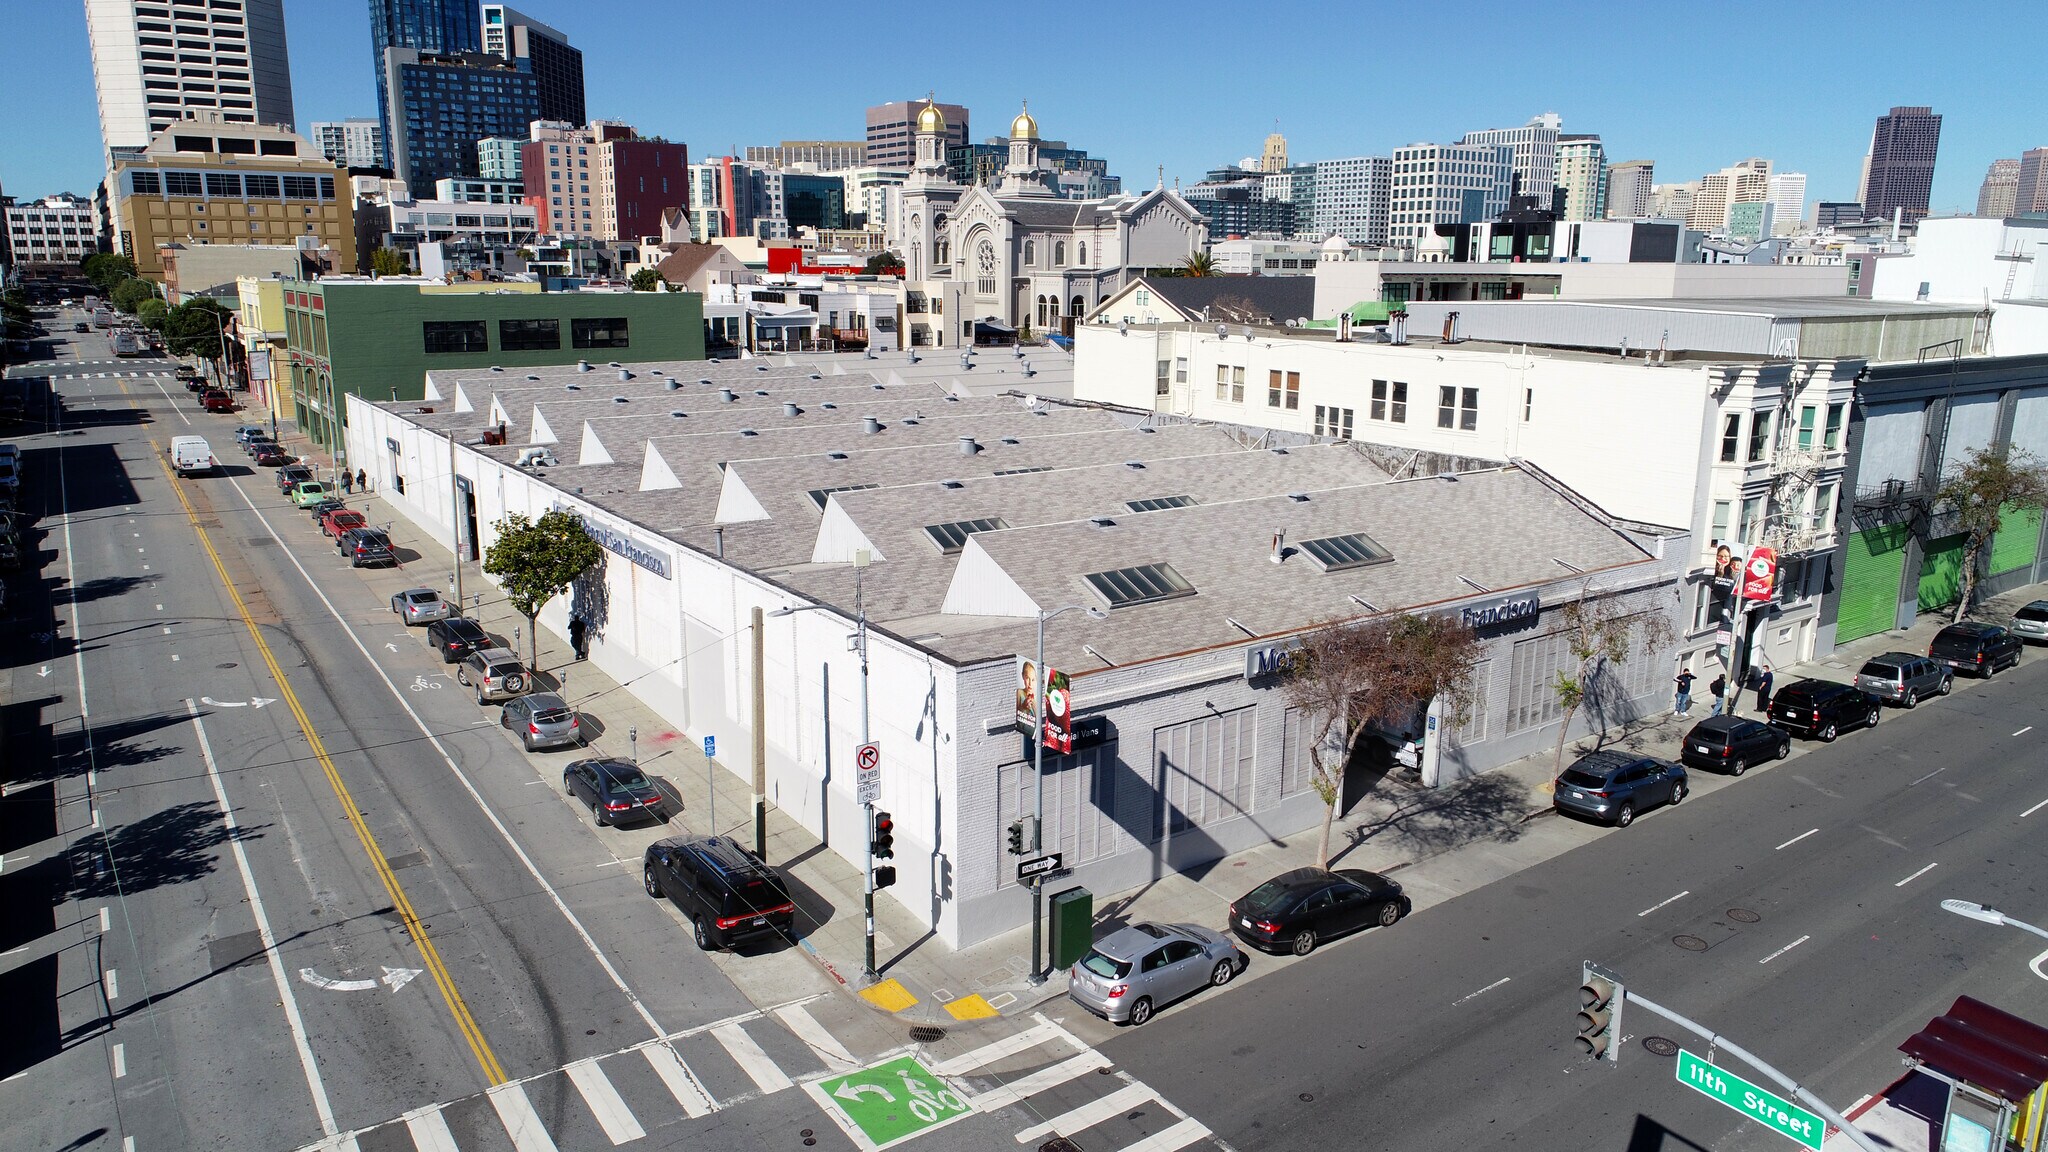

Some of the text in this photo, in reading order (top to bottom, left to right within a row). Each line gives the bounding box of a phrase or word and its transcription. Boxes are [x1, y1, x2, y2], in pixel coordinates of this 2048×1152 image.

[122, 231, 133, 258] STORAGE
[608, 532, 623, 554] San
[624, 539, 665, 576] Francisco
[1748, 581, 1763, 589] FOOD
[1461, 598, 1537, 628] Francisco
[1048, 722, 1062, 733] FOOD
[1081, 728, 1099, 737] Vans
[1048, 730, 1069, 743] FOR all
[868, 770, 878, 779] RED
[860, 783, 879, 792] EXCEPT
[1023, 860, 1049, 873] ONE WAY
[1690, 1063, 1727, 1096] 11th
[1742, 1091, 1812, 1138] Street
